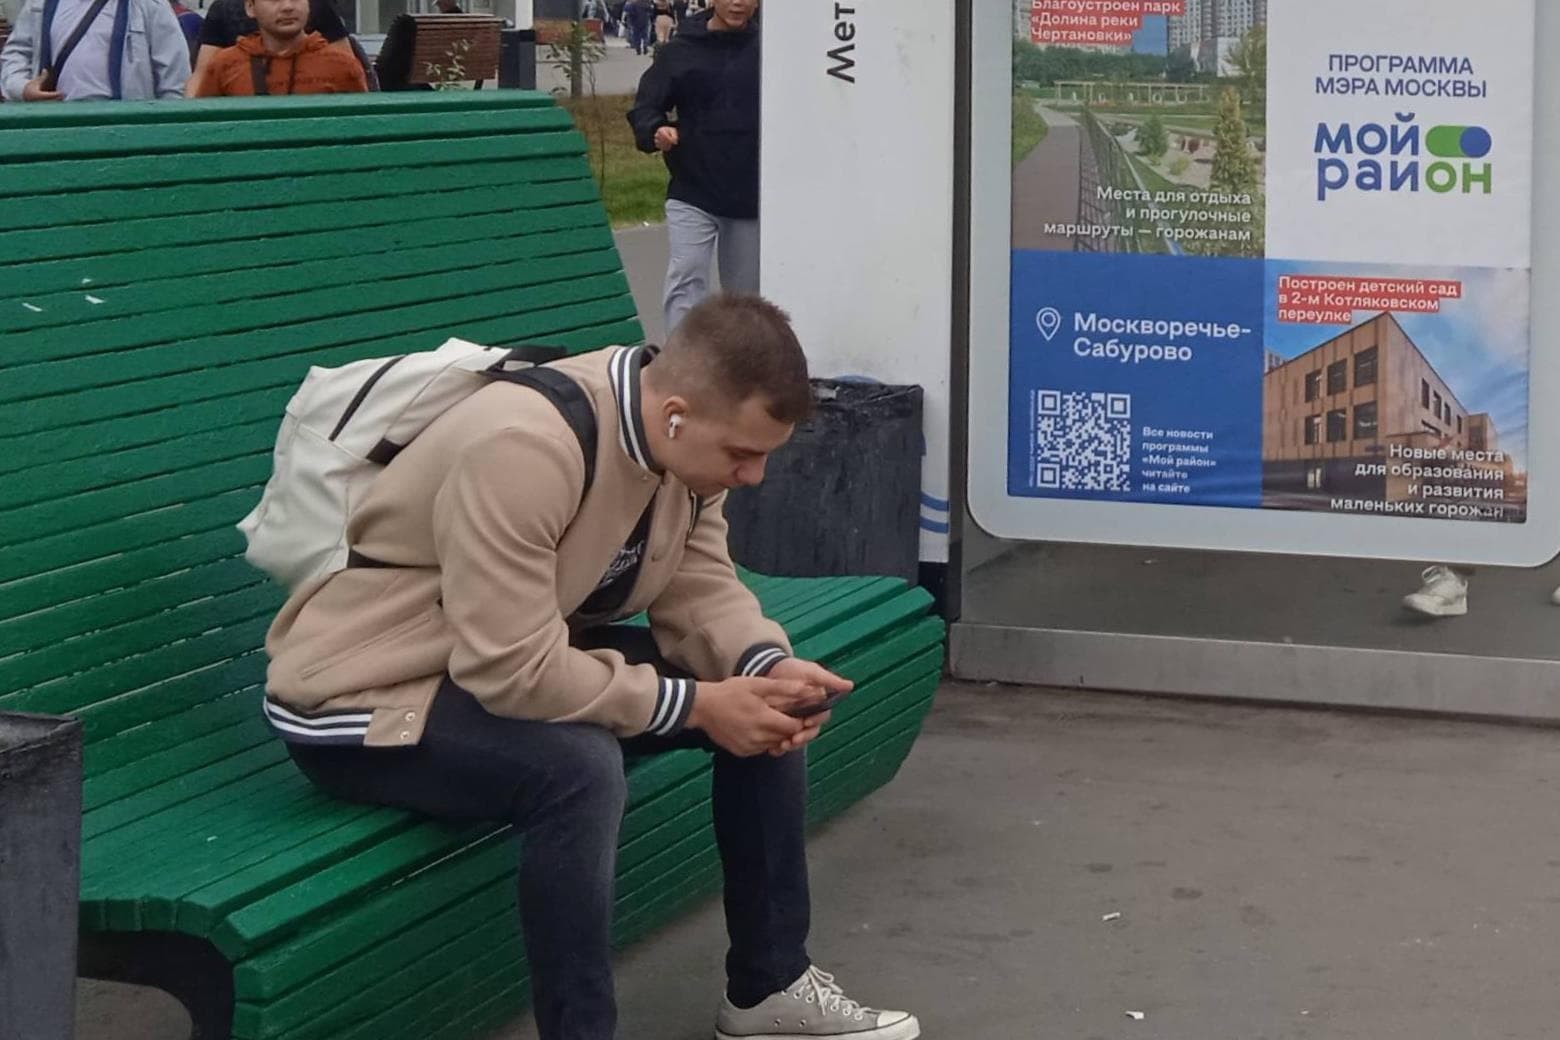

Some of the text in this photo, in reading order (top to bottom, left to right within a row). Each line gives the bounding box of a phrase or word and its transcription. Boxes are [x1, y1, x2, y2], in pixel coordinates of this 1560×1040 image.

[1143, 1, 1180, 15] парк
[1031, 12, 1138, 29] «Долина реки
[1032, 28, 1131, 42] Чертановки»
[1328, 54, 1474, 75] ПРОГРАММА
[1315, 77, 1486, 98] МЭРА МОСКВЫ
[1314, 112, 1419, 156] мой
[1097, 186, 1250, 205] Места для отдыха
[1126, 209, 1251, 224] и прогулочные
[1044, 223, 1133, 238] маршруты
[1156, 225, 1250, 241] горожанам
[1279, 276, 1457, 296] Построен детский сад
[1279, 292, 1439, 310] в 2-м Котляковском
[1279, 310, 1351, 324] переулке
[1074, 312, 1251, 340] Москворечье-
[1073, 337, 1192, 364] Сабурово
[1143, 426, 1214, 439] Все новости
[1142, 442, 1209, 453] программы
[1390, 444, 1503, 462] Новые места
[1142, 454, 1217, 467] «Мой район»
[1142, 468, 1188, 479] читайте
[1355, 464, 1504, 481] для образования
[1142, 482, 1191, 493] на сайте
[1407, 484, 1504, 500] и развития
[1331, 498, 1424, 513] маленьких
